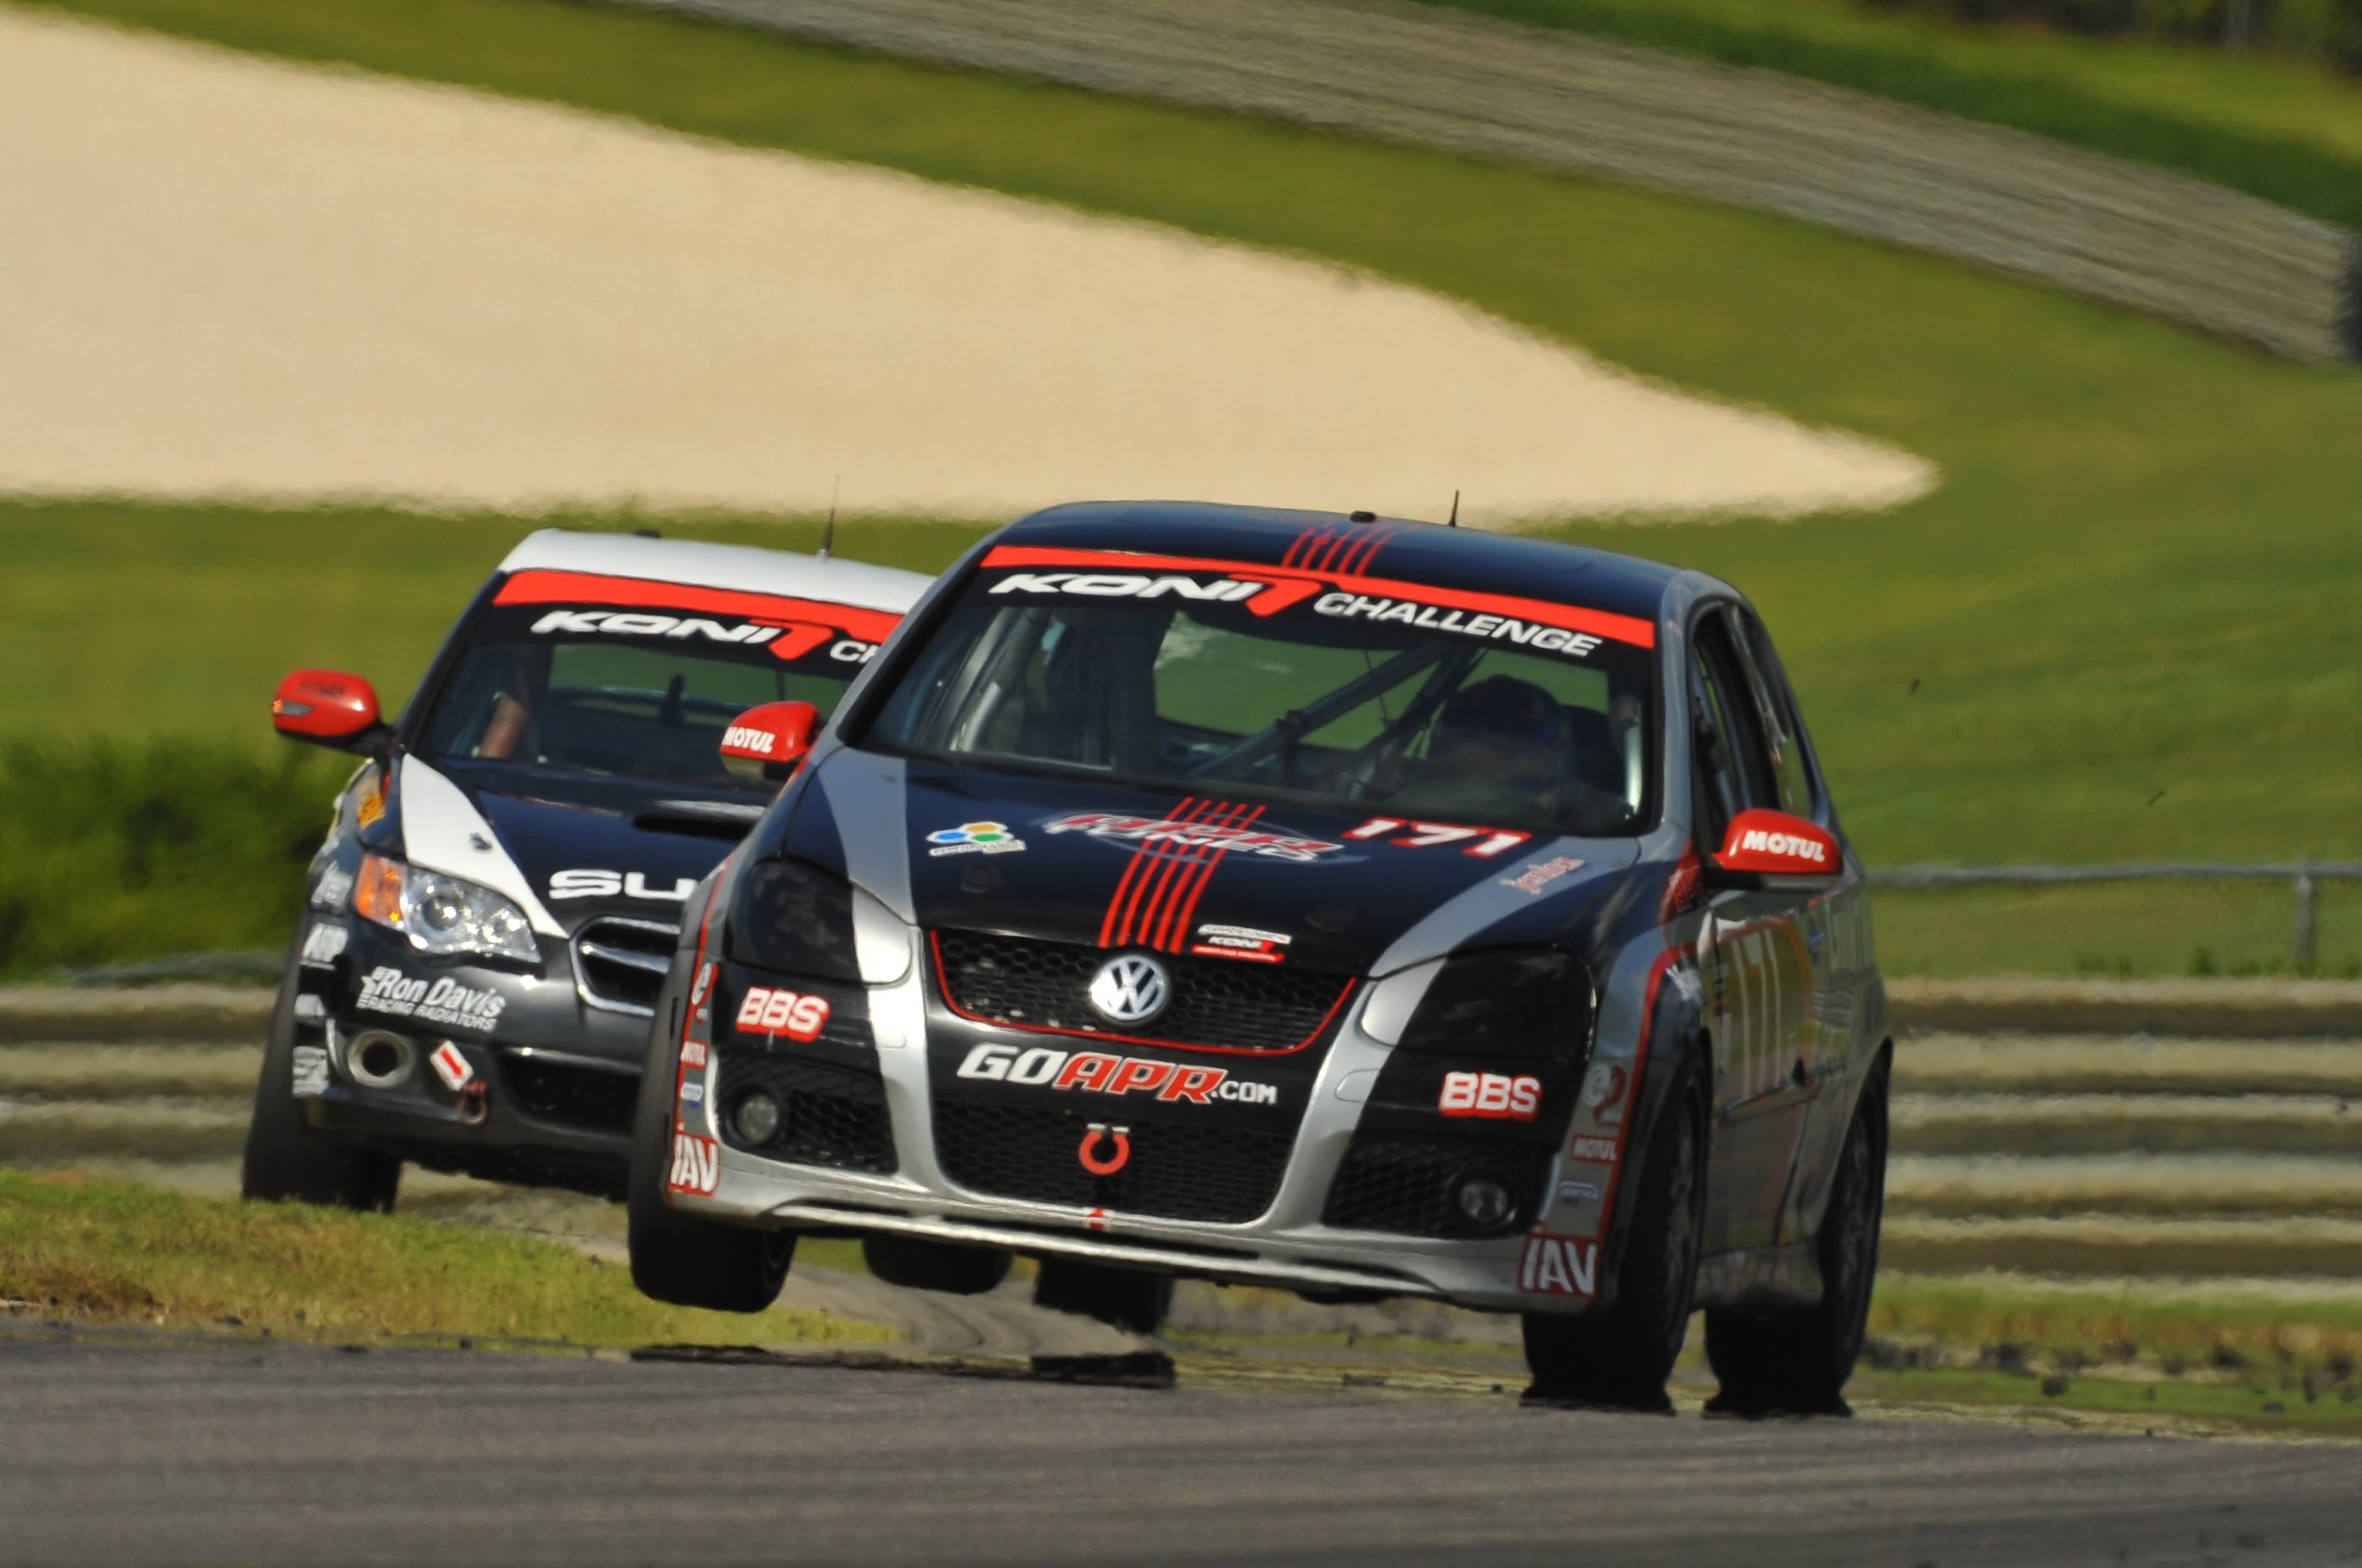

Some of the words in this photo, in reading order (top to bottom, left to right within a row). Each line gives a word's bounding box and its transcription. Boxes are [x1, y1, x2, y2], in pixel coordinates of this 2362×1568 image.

[1313, 592, 1603, 659] CHALLENGE
[721, 726, 775, 753] MOTUL
[1341, 815, 1532, 858] 171
[1741, 830, 1826, 863] MOTUL
[374, 966, 428, 1002] Ron
[424, 977, 507, 1018] Davis
[736, 986, 830, 1037] BBS
[414, 1005, 498, 1033] RADIATORS
[1441, 1071, 1542, 1120] BBS
[670, 1134, 719, 1193] IAV
[1523, 1238, 1597, 1295] IAV
